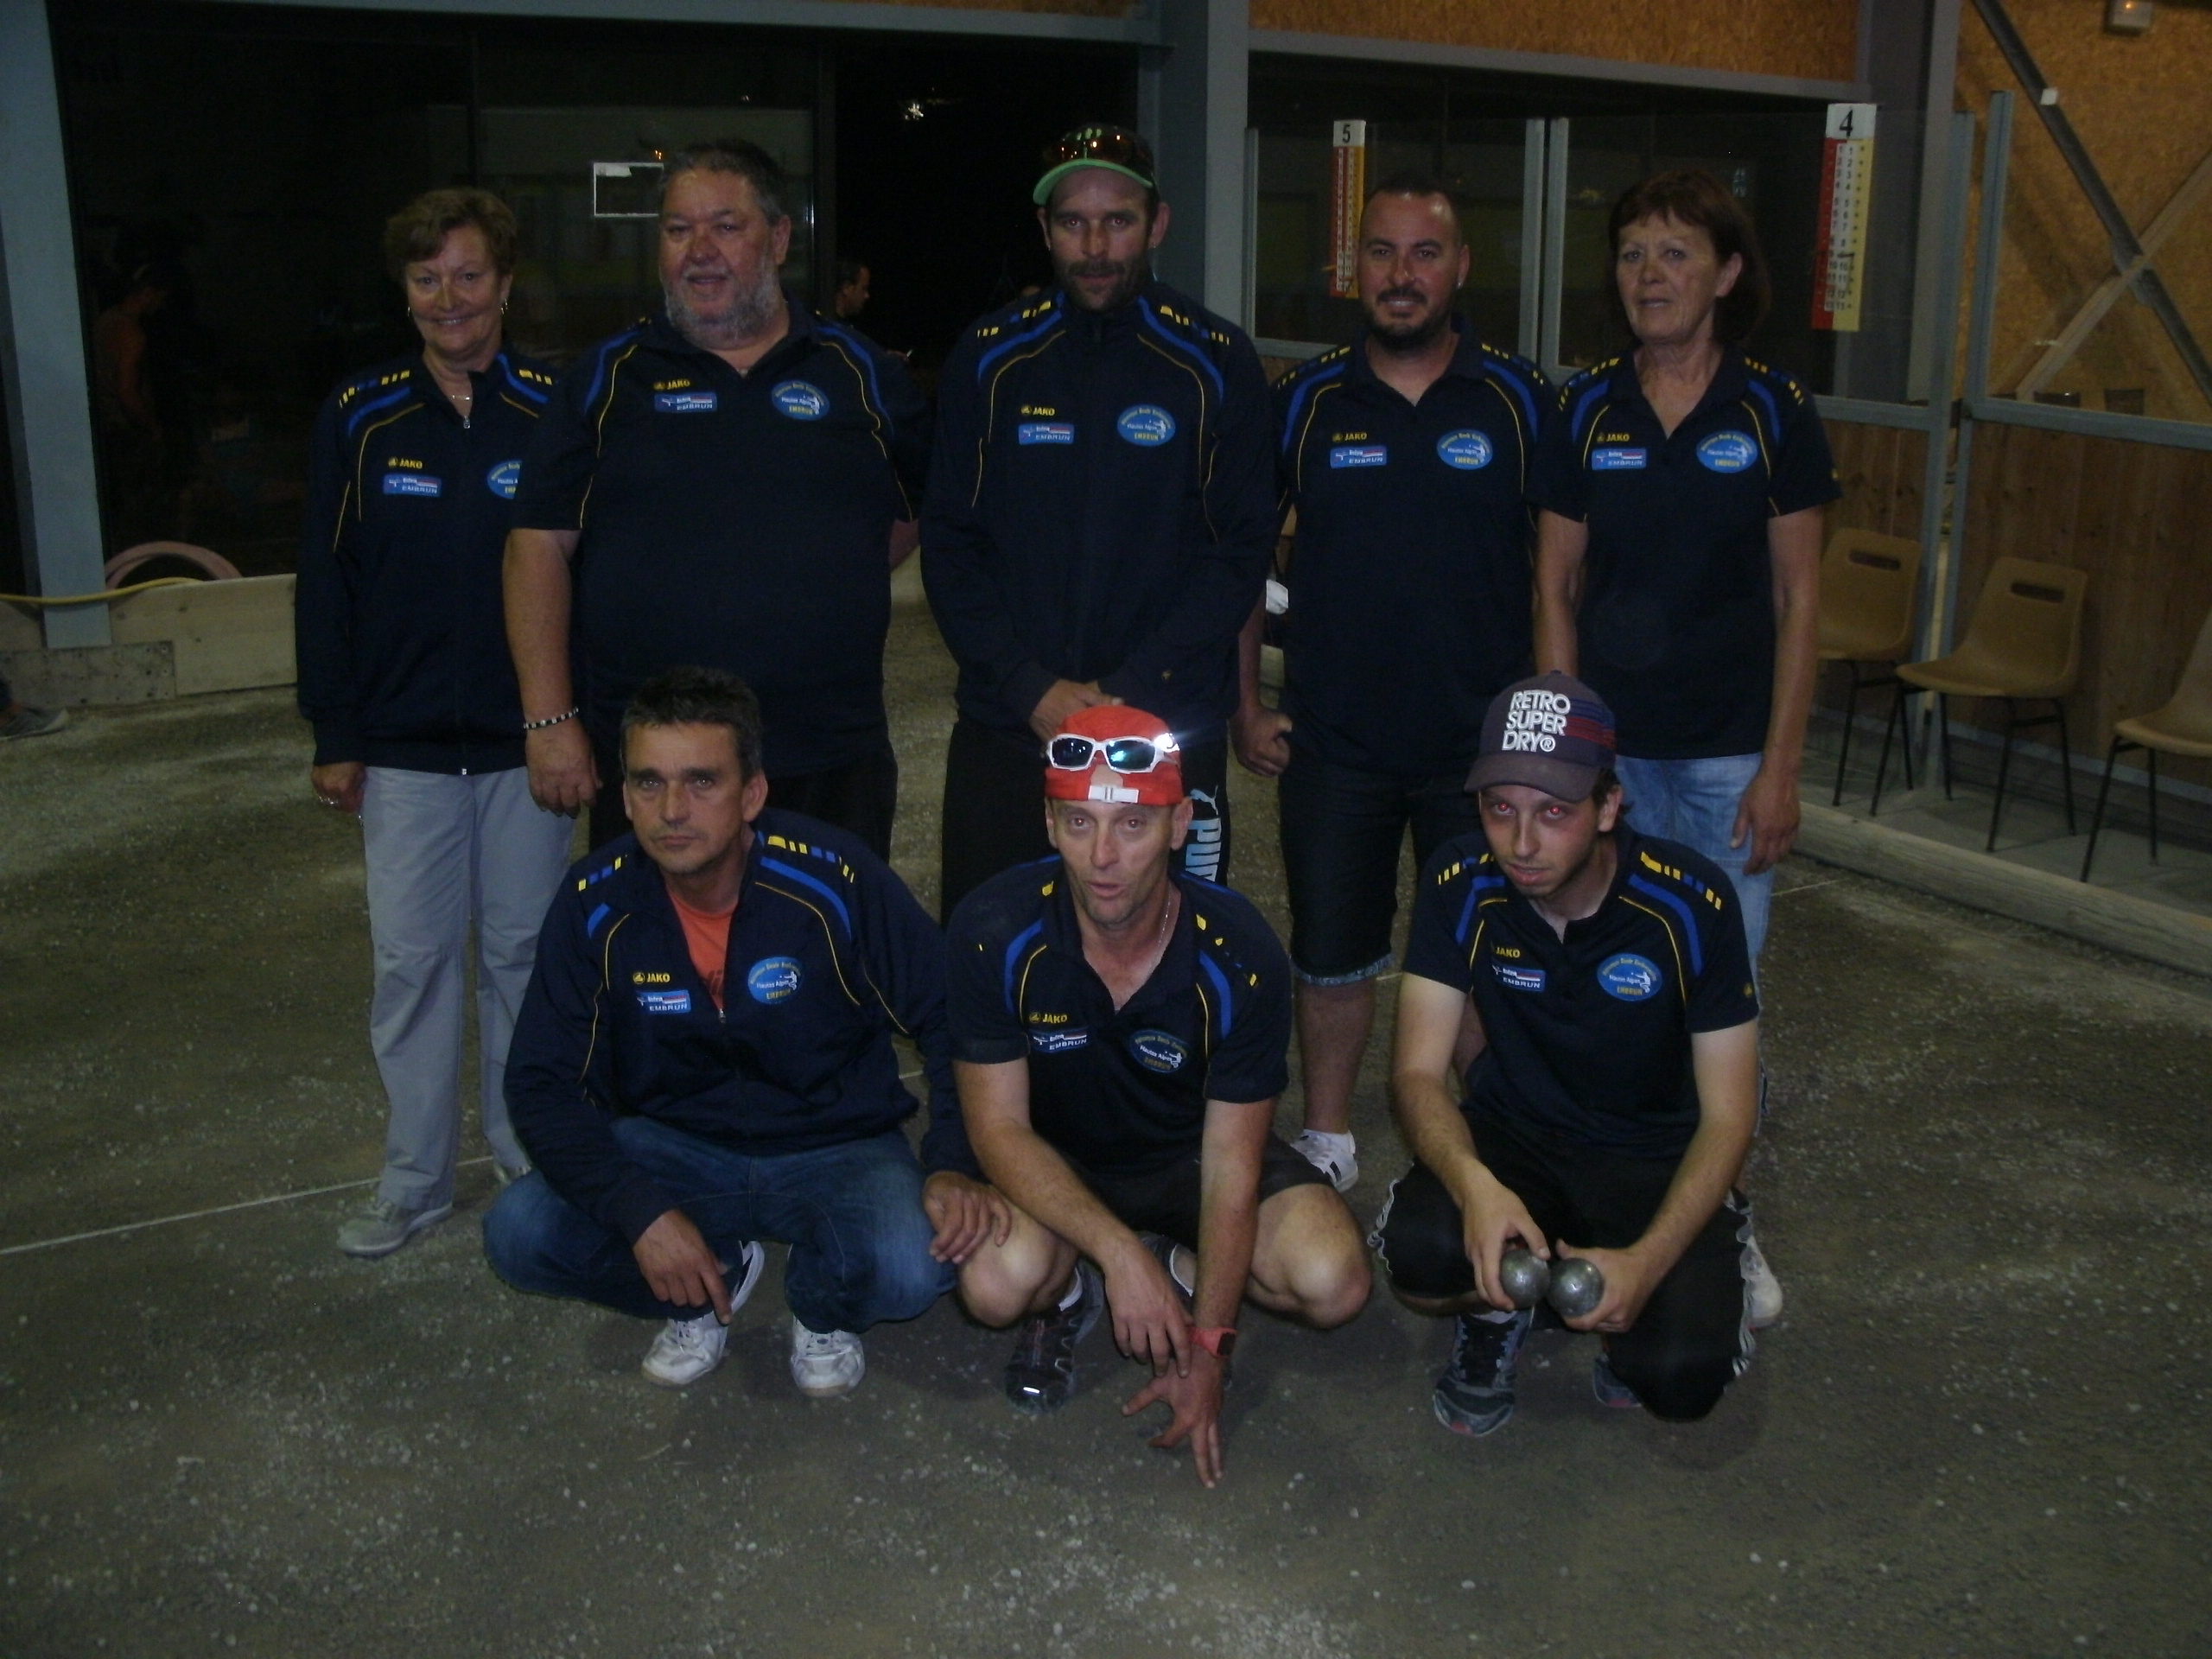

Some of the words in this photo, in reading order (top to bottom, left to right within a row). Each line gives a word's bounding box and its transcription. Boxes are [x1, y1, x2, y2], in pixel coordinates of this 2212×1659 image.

[1839, 109, 1853, 137] 4
[1343, 123, 1351, 143] 5
[667, 378, 690, 390] JAKO
[1033, 407, 1056, 416] JAKO
[1344, 432, 1368, 442] JAKO
[1605, 434, 1630, 442] JAKO
[399, 458, 423, 470] JAKO
[1510, 689, 1571, 715] RETRO
[1506, 710, 1567, 736] SUPER
[1185, 817, 1222, 882] PU
[1496, 947, 1521, 958] JAKO
[646, 973, 671, 983] JAKO
[1503, 977, 1541, 988] EMBRUN
[649, 1003, 688, 1012] EMBRUN
[1042, 1014, 1068, 1024] JAKO
[1049, 1038, 1087, 1051] EMBRUN
